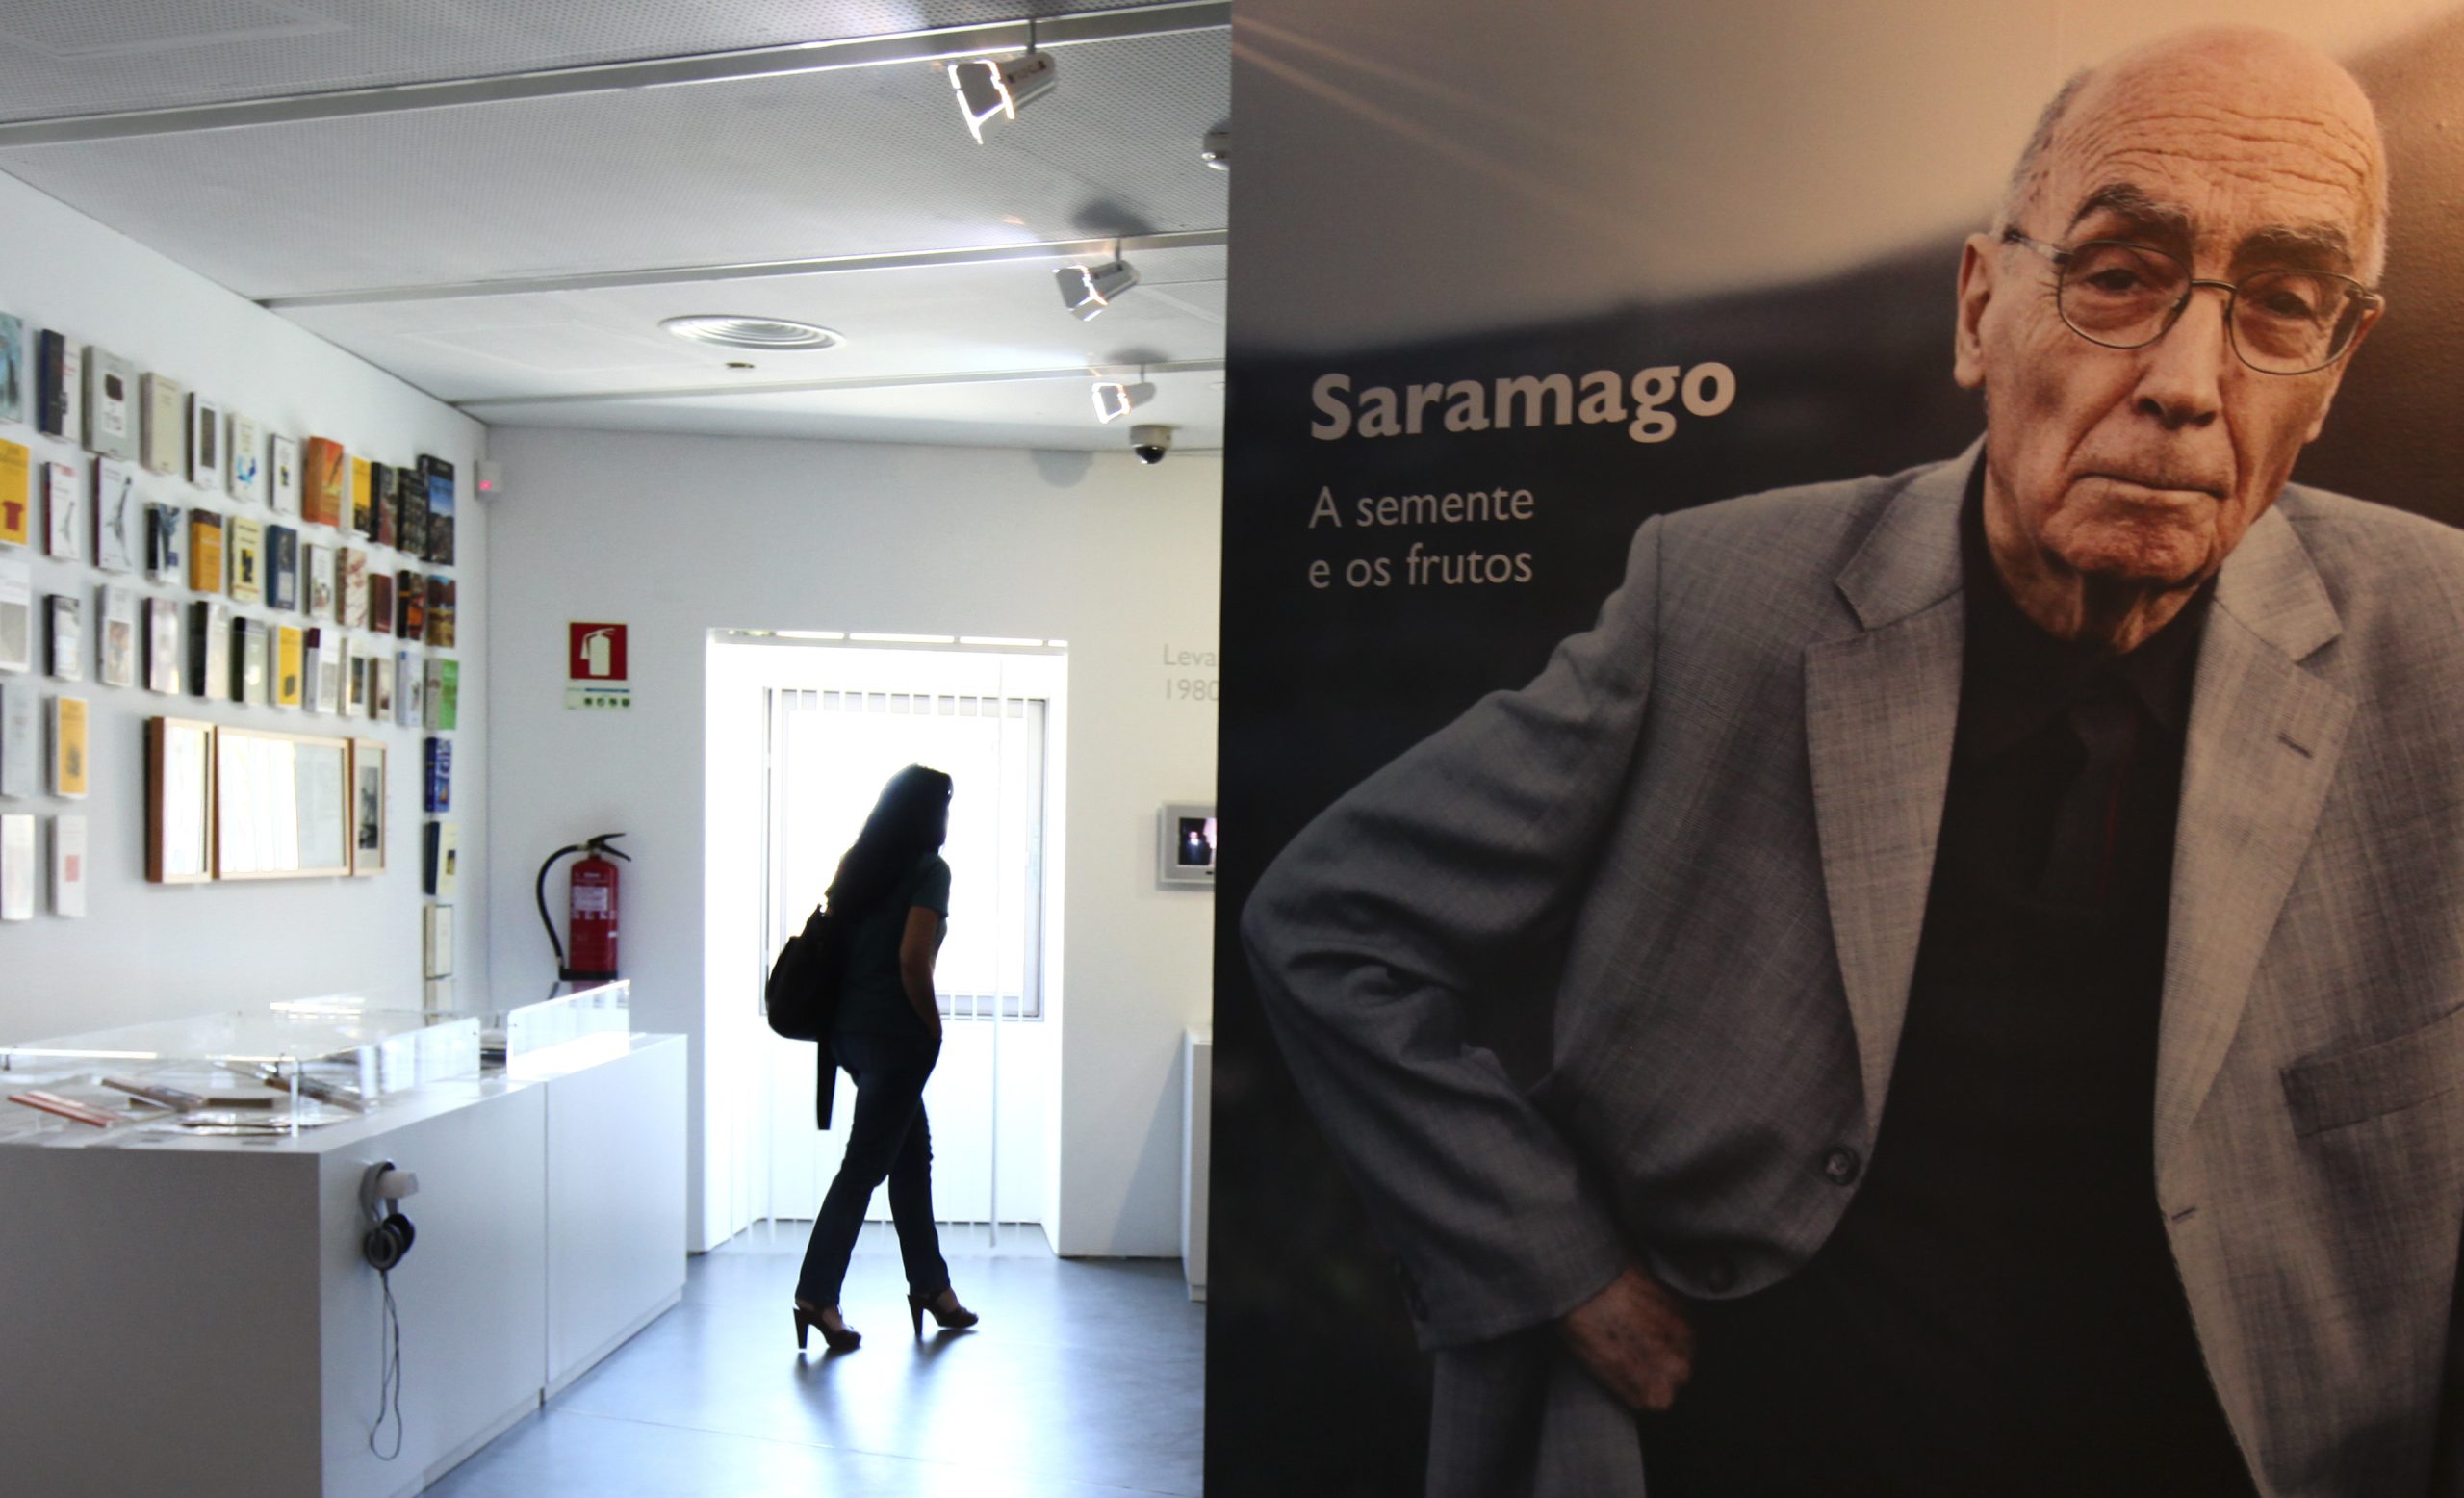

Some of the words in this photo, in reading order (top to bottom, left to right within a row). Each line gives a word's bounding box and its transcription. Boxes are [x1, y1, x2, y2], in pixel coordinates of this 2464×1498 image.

[1311, 361, 1736, 443] Saramago
[1308, 485, 1342, 529] A
[1356, 488, 1534, 527] semente
[1308, 559, 1331, 589] e
[1347, 555, 1392, 588] os
[1406, 542, 1533, 585] frutos
